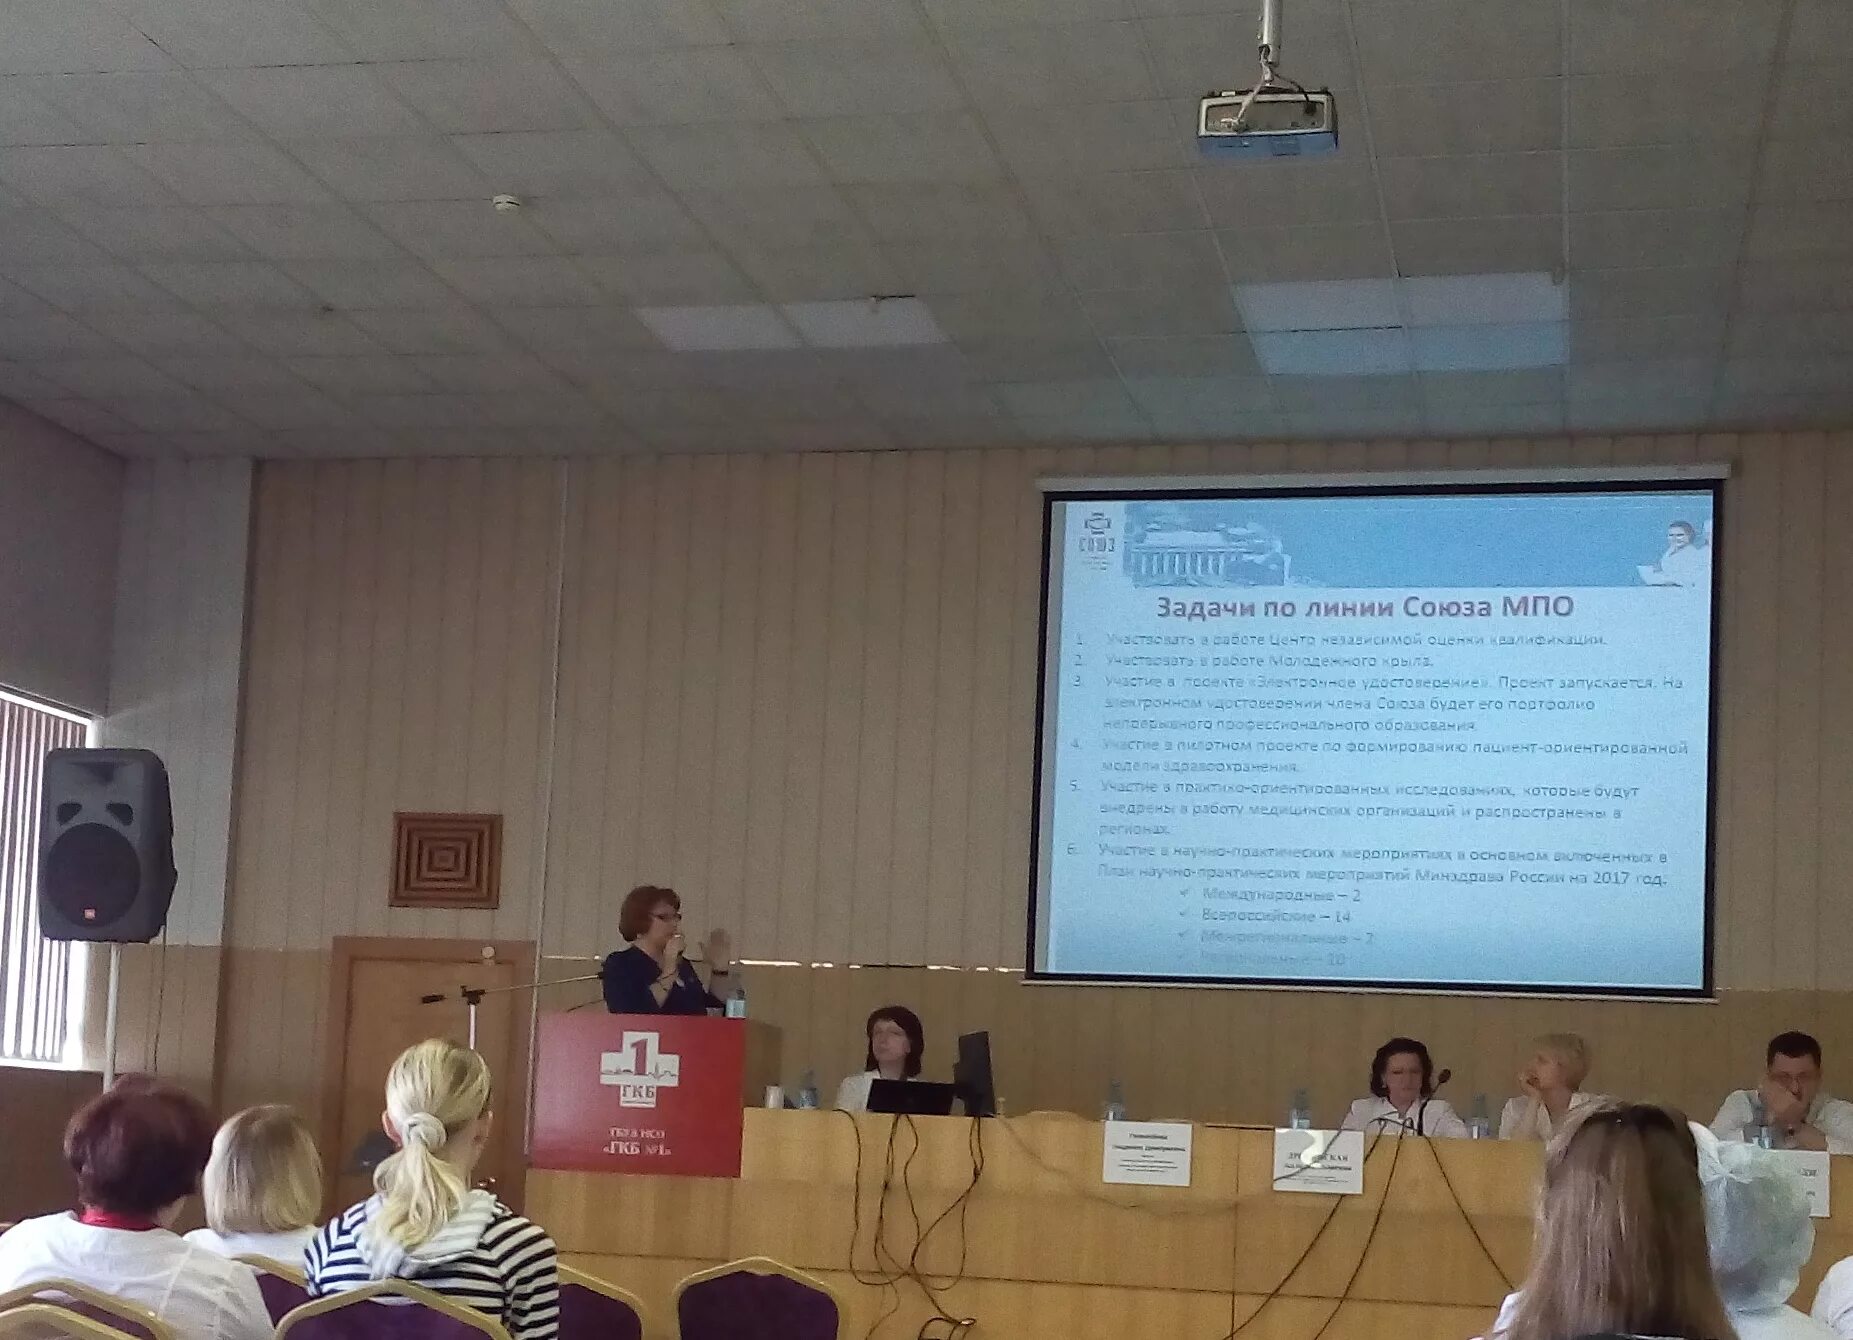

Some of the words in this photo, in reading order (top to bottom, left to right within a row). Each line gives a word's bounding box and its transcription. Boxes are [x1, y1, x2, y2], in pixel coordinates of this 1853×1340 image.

[1157, 597, 1256, 622] Задачи
[1263, 601, 1297, 618] по
[1305, 601, 1394, 618] линии
[1403, 596, 1492, 618] Союза
[1502, 595, 1575, 617] МПО
[1107, 633, 1196, 646] Участвовать
[1106, 654, 1195, 667] Участвовать
[1104, 676, 1162, 688] Участие
[1499, 675, 1554, 691] Проект
[1663, 676, 1684, 689] На
[1328, 700, 1371, 710] члена
[1377, 696, 1425, 710] Союза
[1430, 696, 1475, 712] будет
[1478, 700, 1504, 712] его
[1323, 742, 1341, 752] по
[1101, 780, 1158, 793] Участие
[1594, 783, 1640, 800] будут
[1192, 801, 1244, 817] работу
[1475, 807, 1607, 822] распространены
[1470, 851, 1550, 862] основном
[1509, 869, 1566, 884] России
[1569, 873, 1588, 884] на
[1592, 871, 1631, 885] 2017
[1202, 887, 1334, 902] Международные
[1352, 888, 1361, 902] 2
[630, 1038, 649, 1076] 1
[622, 1085, 656, 1099] ГКБ
